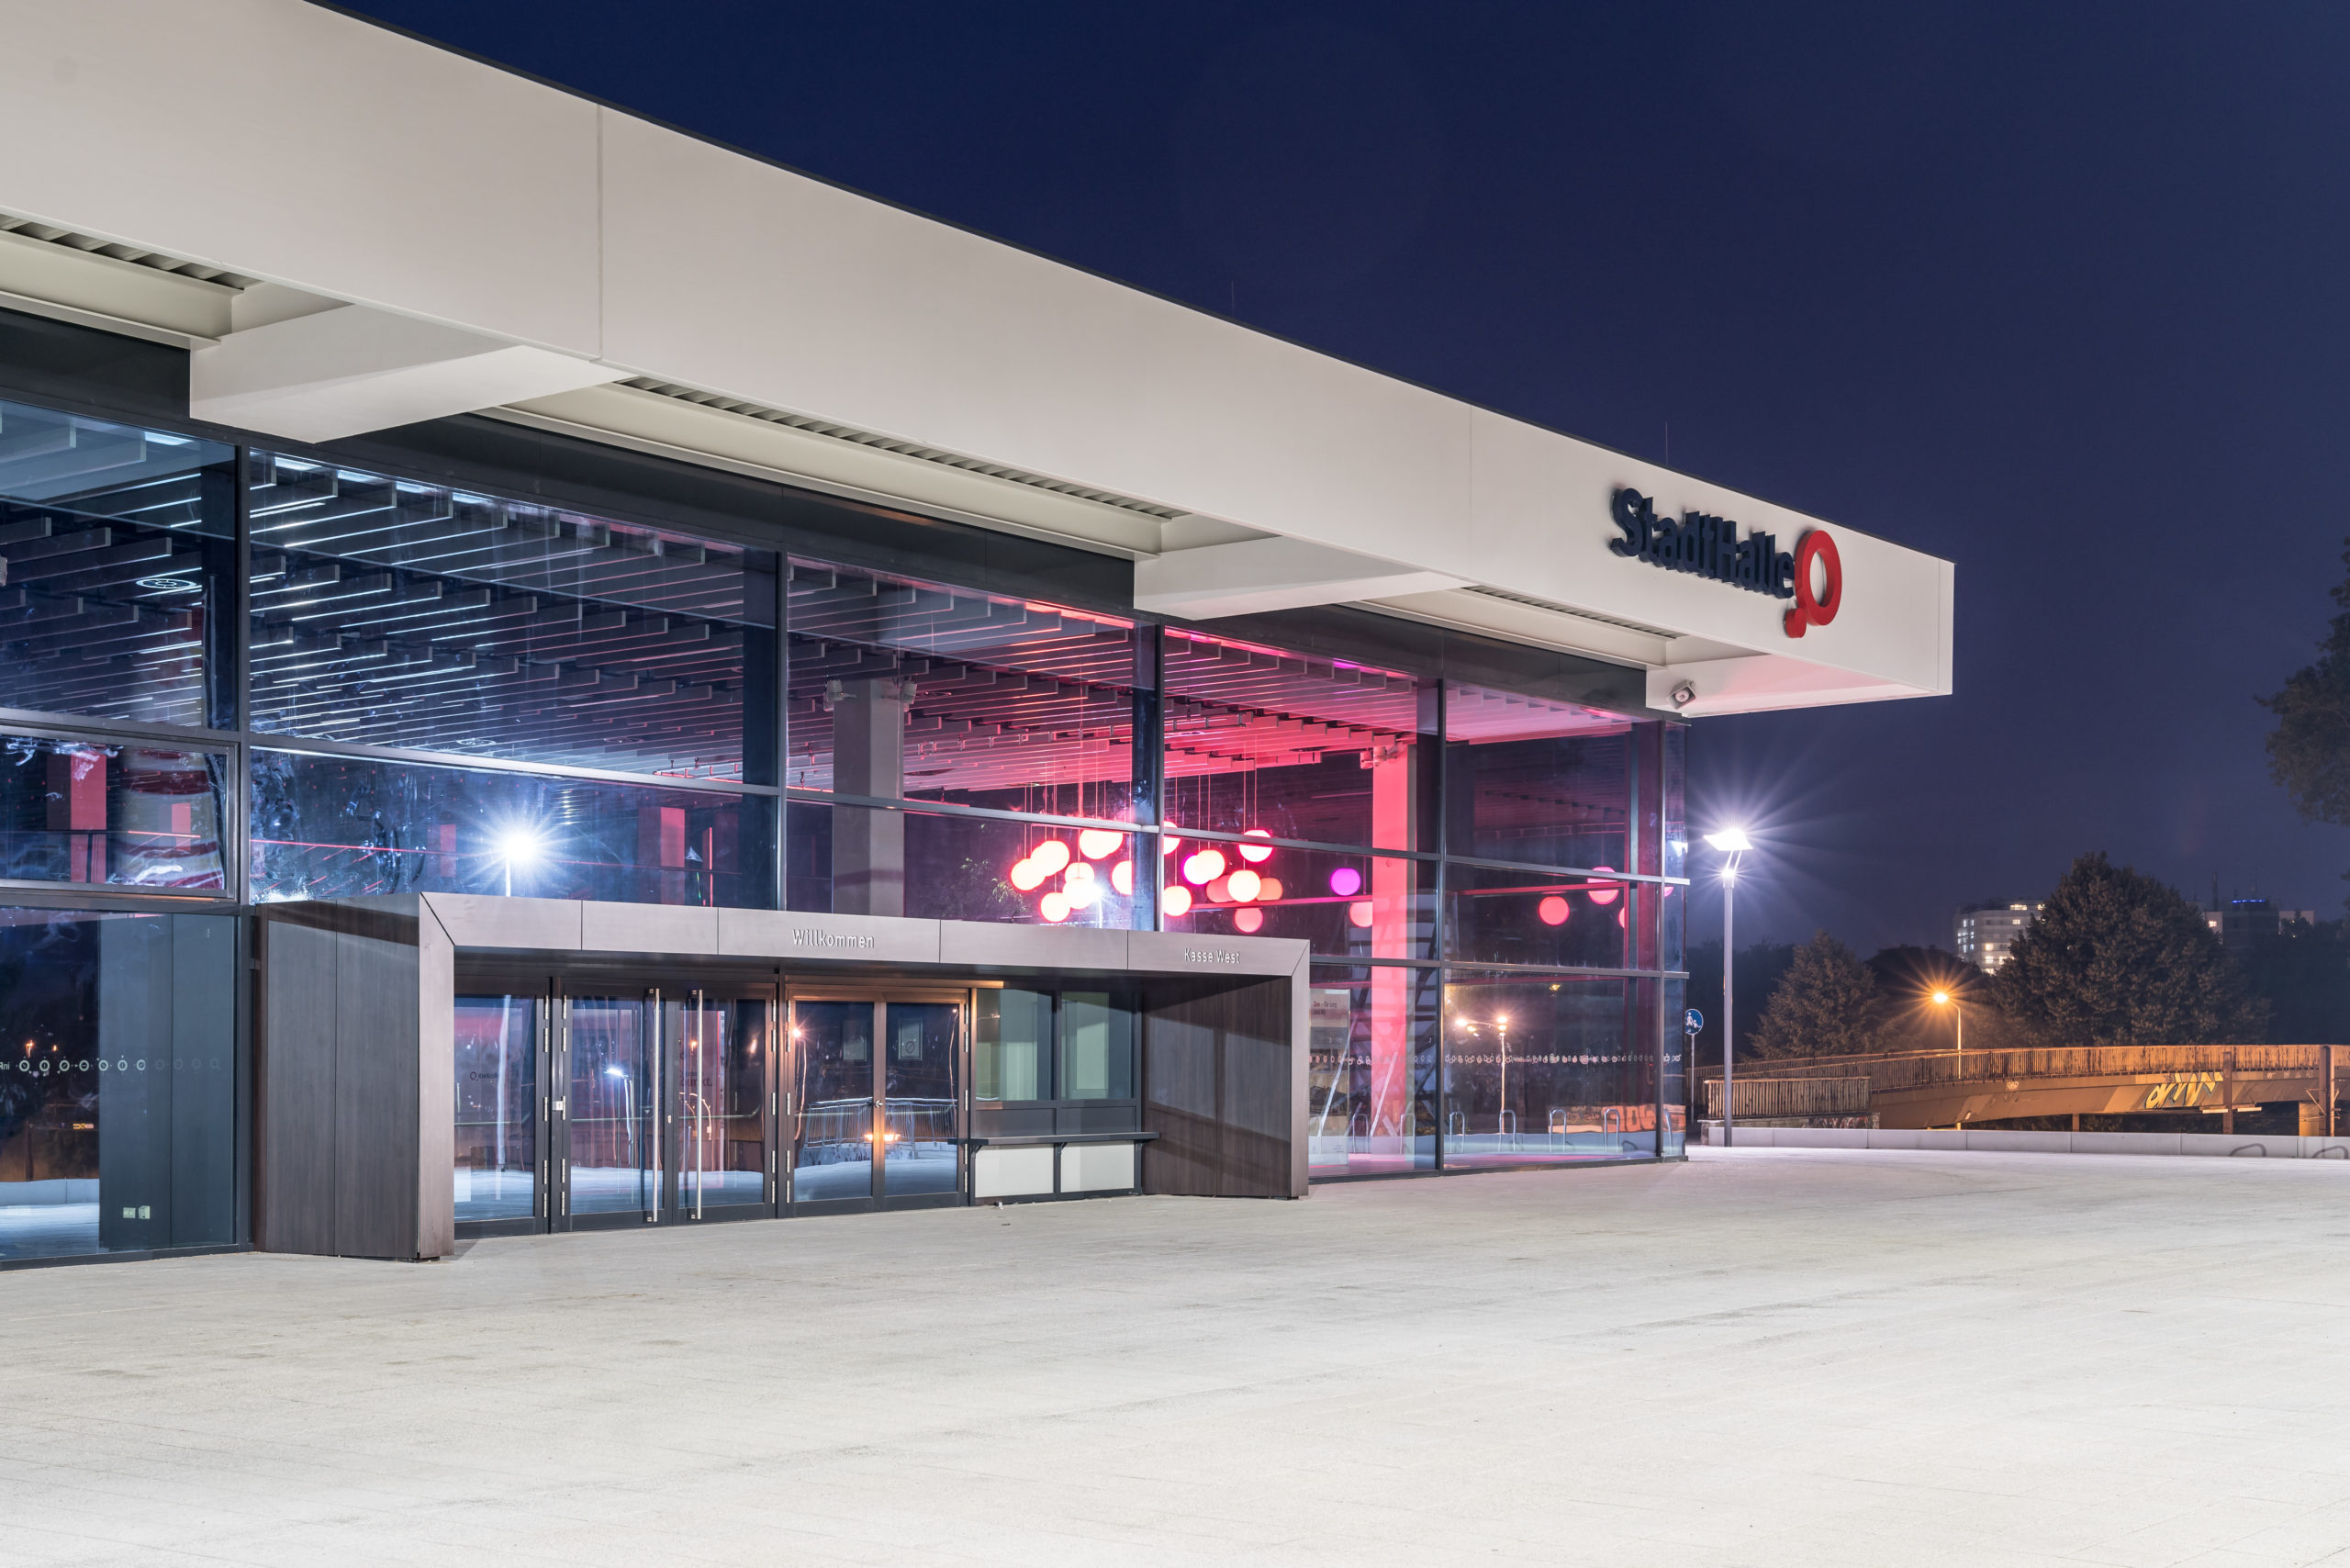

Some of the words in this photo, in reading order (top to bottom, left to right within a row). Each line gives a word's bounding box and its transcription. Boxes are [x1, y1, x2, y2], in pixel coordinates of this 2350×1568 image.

[1609, 487, 1796, 599] StadtHalle
[792, 928, 875, 949] Willkommen
[1184, 947, 1214, 963] Kasse
[1216, 948, 1241, 965] West
